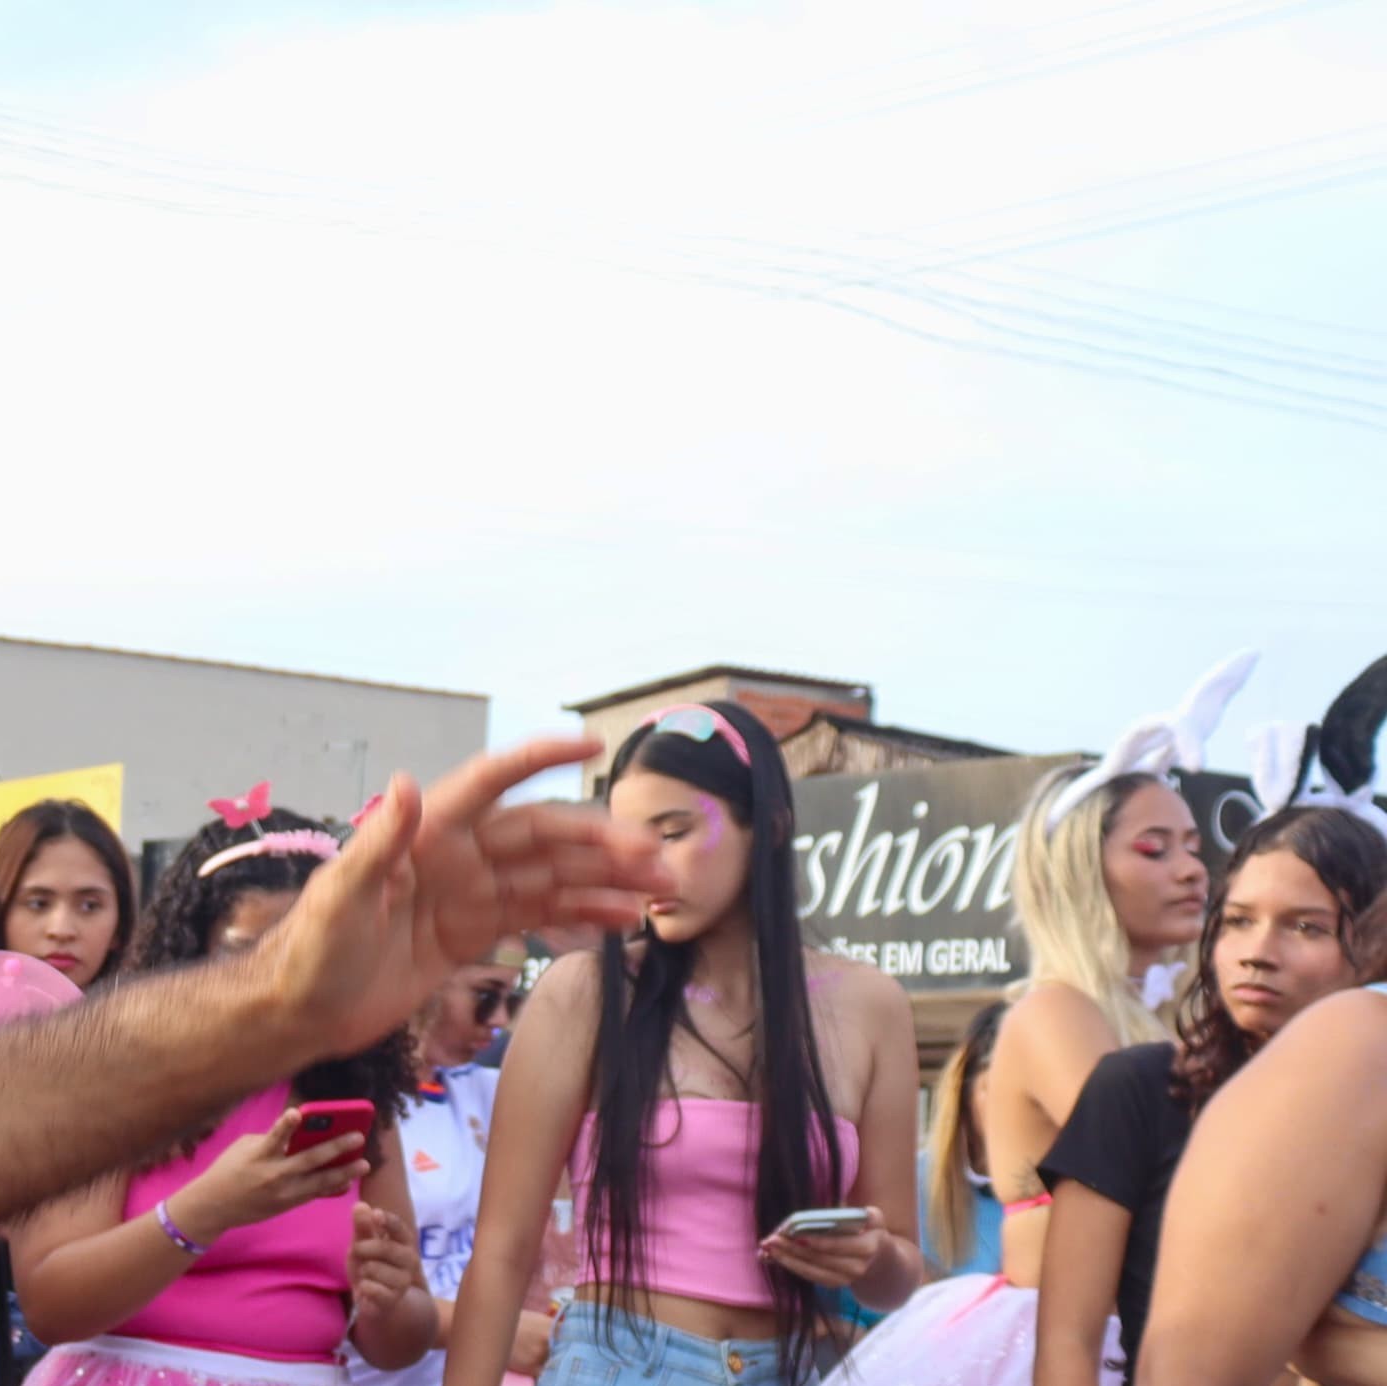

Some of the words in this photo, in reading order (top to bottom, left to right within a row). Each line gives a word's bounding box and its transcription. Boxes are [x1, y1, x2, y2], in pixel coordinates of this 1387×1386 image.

[793, 781, 1023, 919] shion
[882, 941, 924, 975] EM
[929, 937, 1012, 974] GERAL
